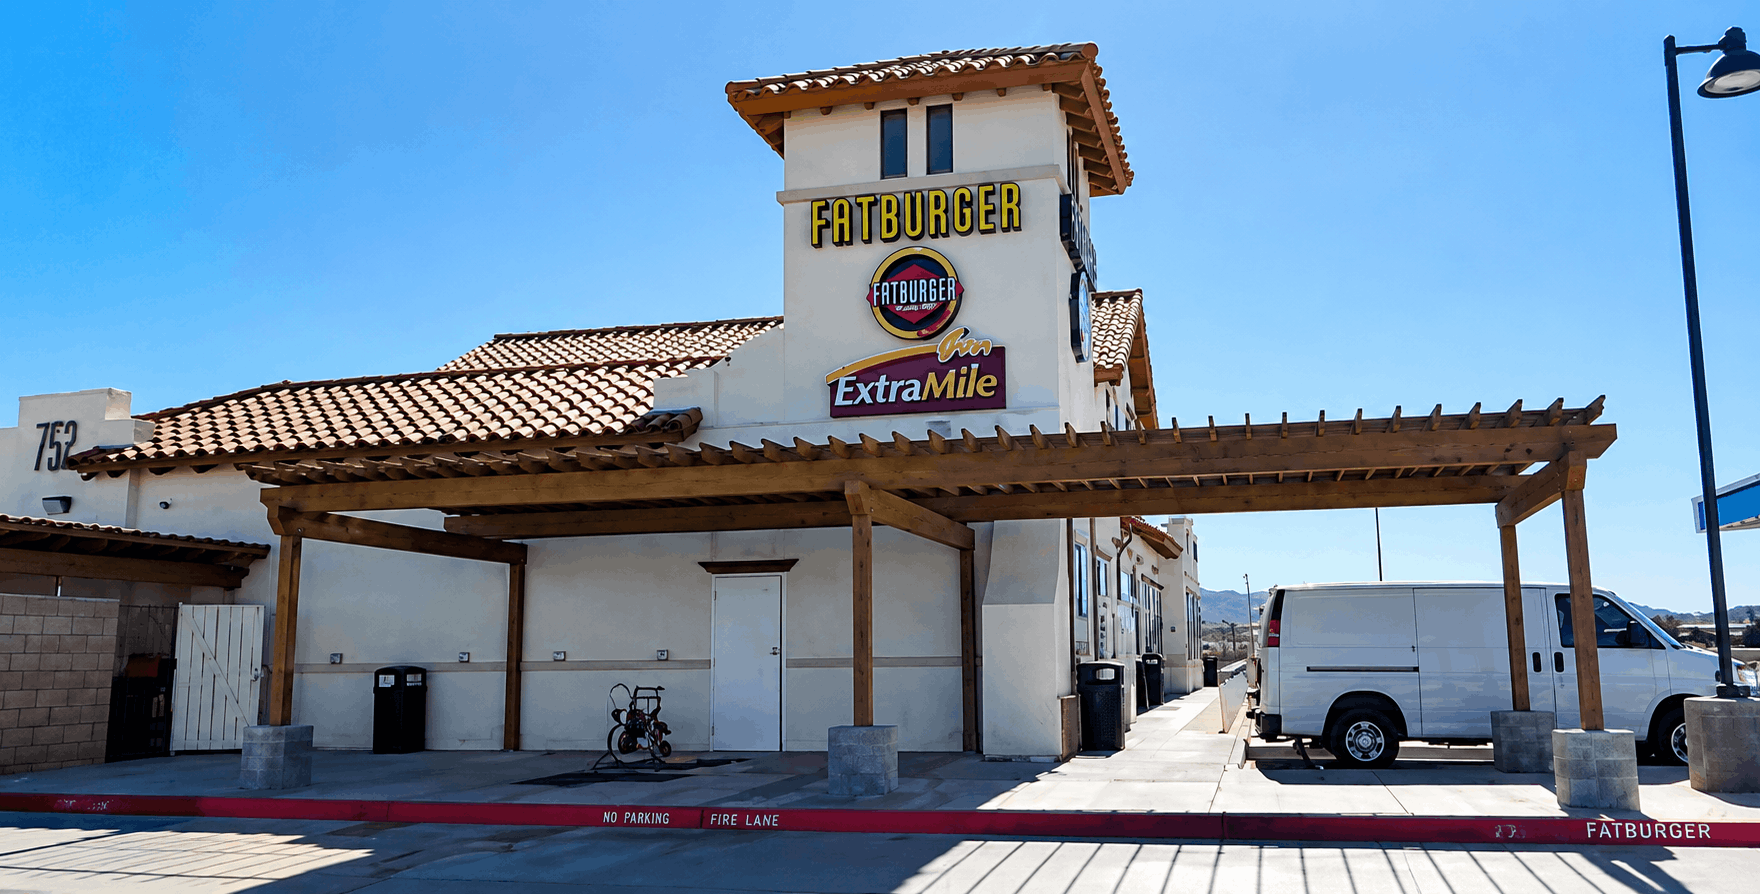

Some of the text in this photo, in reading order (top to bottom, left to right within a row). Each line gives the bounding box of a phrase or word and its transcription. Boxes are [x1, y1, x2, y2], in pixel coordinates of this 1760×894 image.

[810, 182, 1021, 247] FATBURGER
[873, 277, 956, 307] FATBURGER
[834, 363, 998, 406] ExtraMile
[34, 420, 77, 471] 752
[602, 811, 780, 827] NO PARKING FIRE LANE
[1586, 821, 1711, 839] FATBURGER
